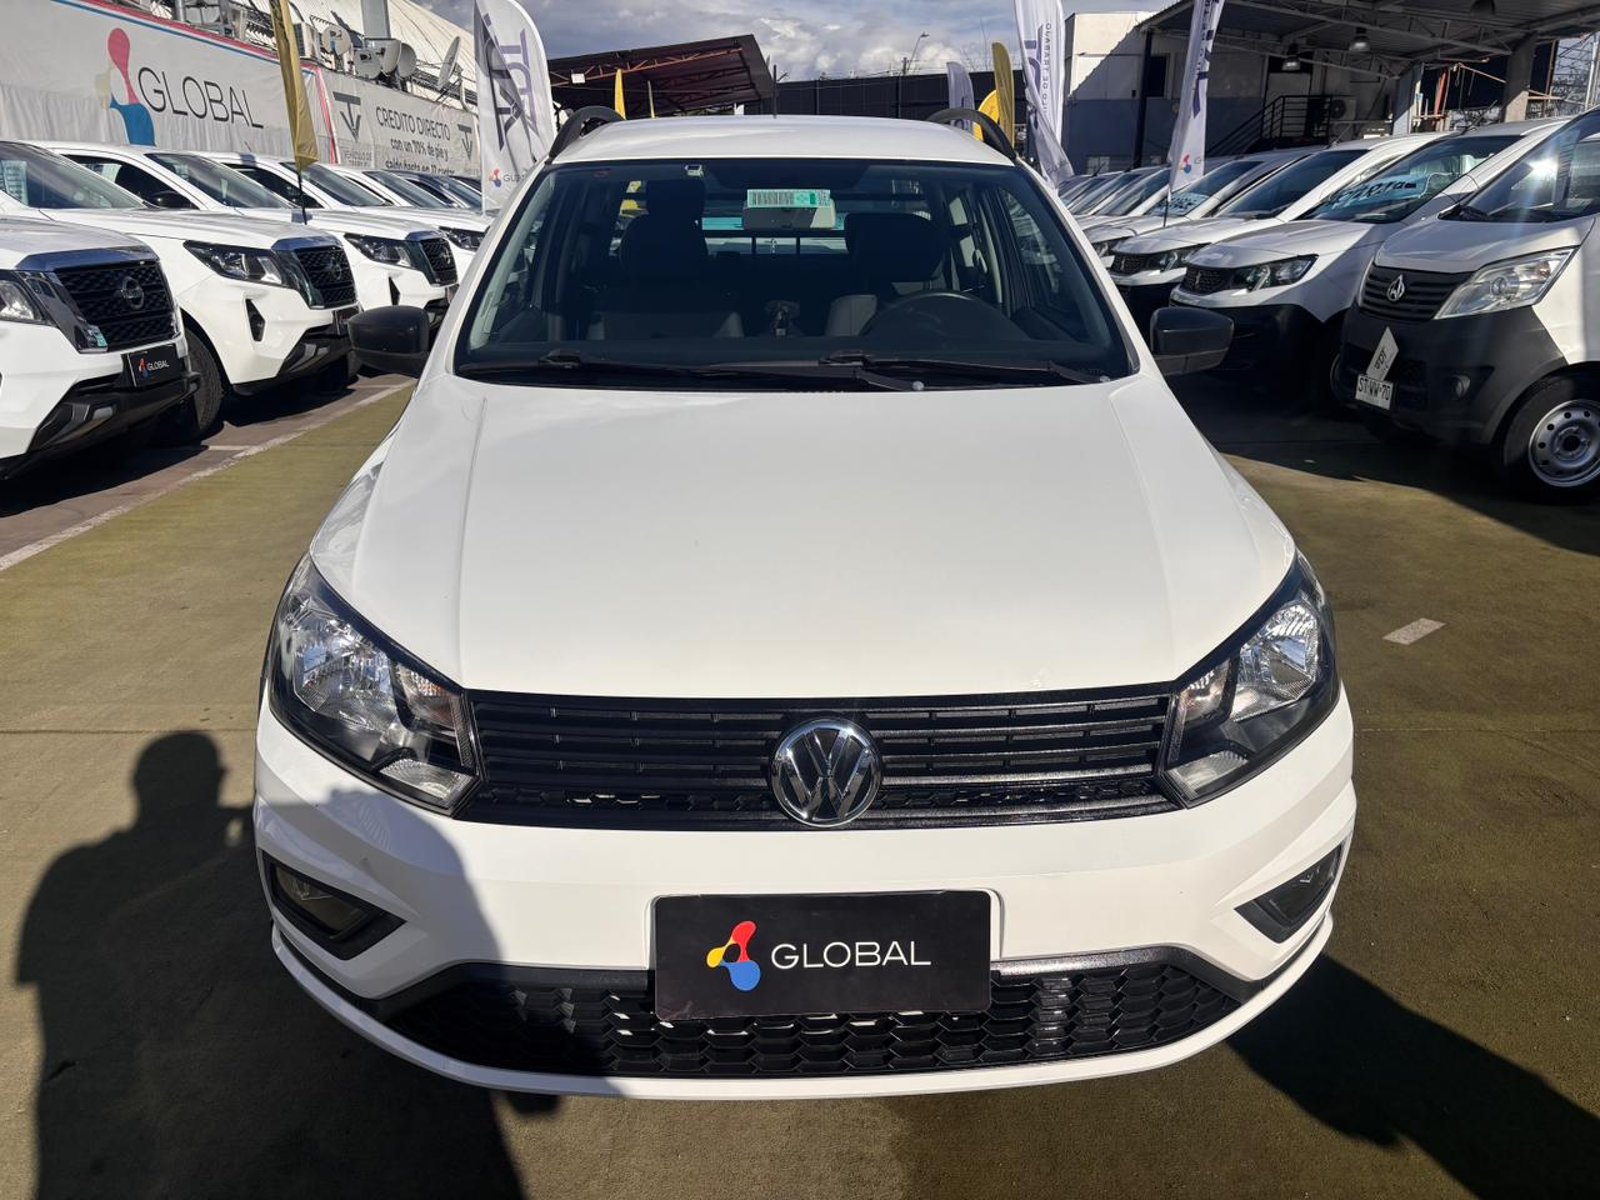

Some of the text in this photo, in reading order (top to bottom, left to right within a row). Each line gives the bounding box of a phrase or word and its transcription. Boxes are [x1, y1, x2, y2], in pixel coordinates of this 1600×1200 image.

[138, 67, 264, 129] GLOBAL
[416, 116, 451, 141] DIRECTO
[771, 940, 932, 969] GLOBAL
